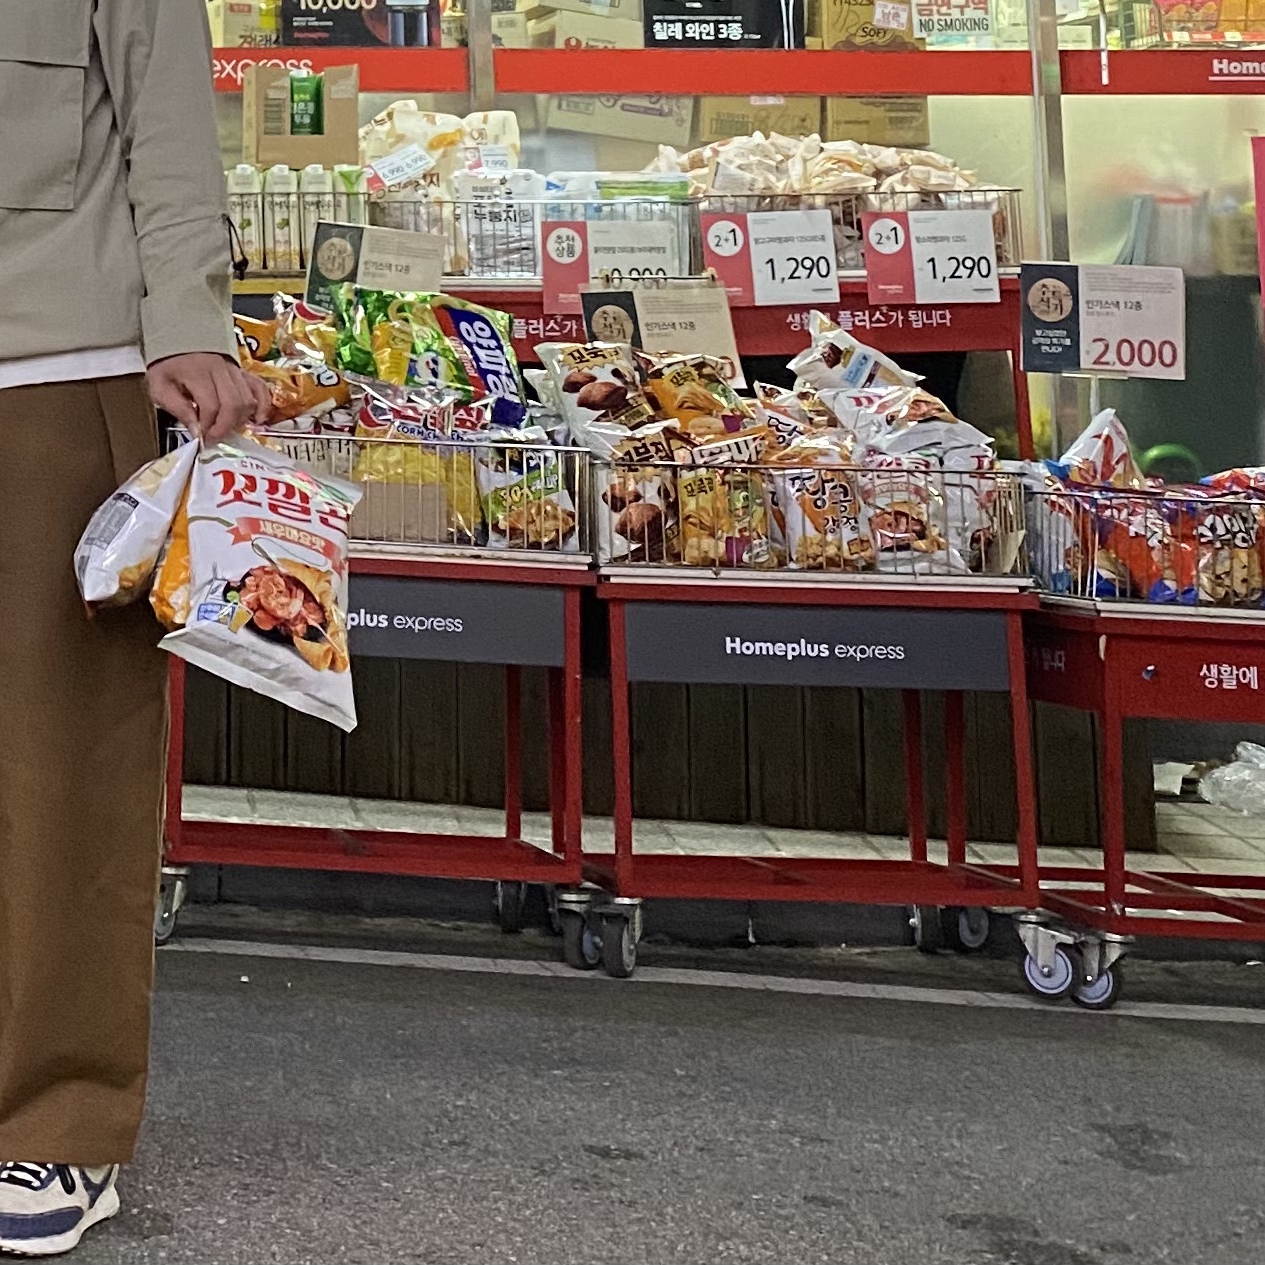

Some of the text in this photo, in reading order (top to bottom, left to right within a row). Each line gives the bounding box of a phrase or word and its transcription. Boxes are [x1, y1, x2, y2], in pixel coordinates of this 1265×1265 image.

[653, 22, 744, 40] 칠레 와인 3종
[919, 17, 990, 33] NO SMOKING
[714, 226, 739, 249] 2+1
[875, 225, 901, 246] 2+1
[766, 255, 831, 283] 1,290
[926, 255, 992, 283] 1,290
[1123, 299, 1143, 311] 12종
[837, 310, 903, 330] 플러스가
[907, 309, 952, 328] 됩니다
[1092, 337, 1178, 367] 2,000
[393, 614, 463, 633] express
[725, 636, 905, 662] Homeplus express
[1199, 663, 1259, 689] 생활에
